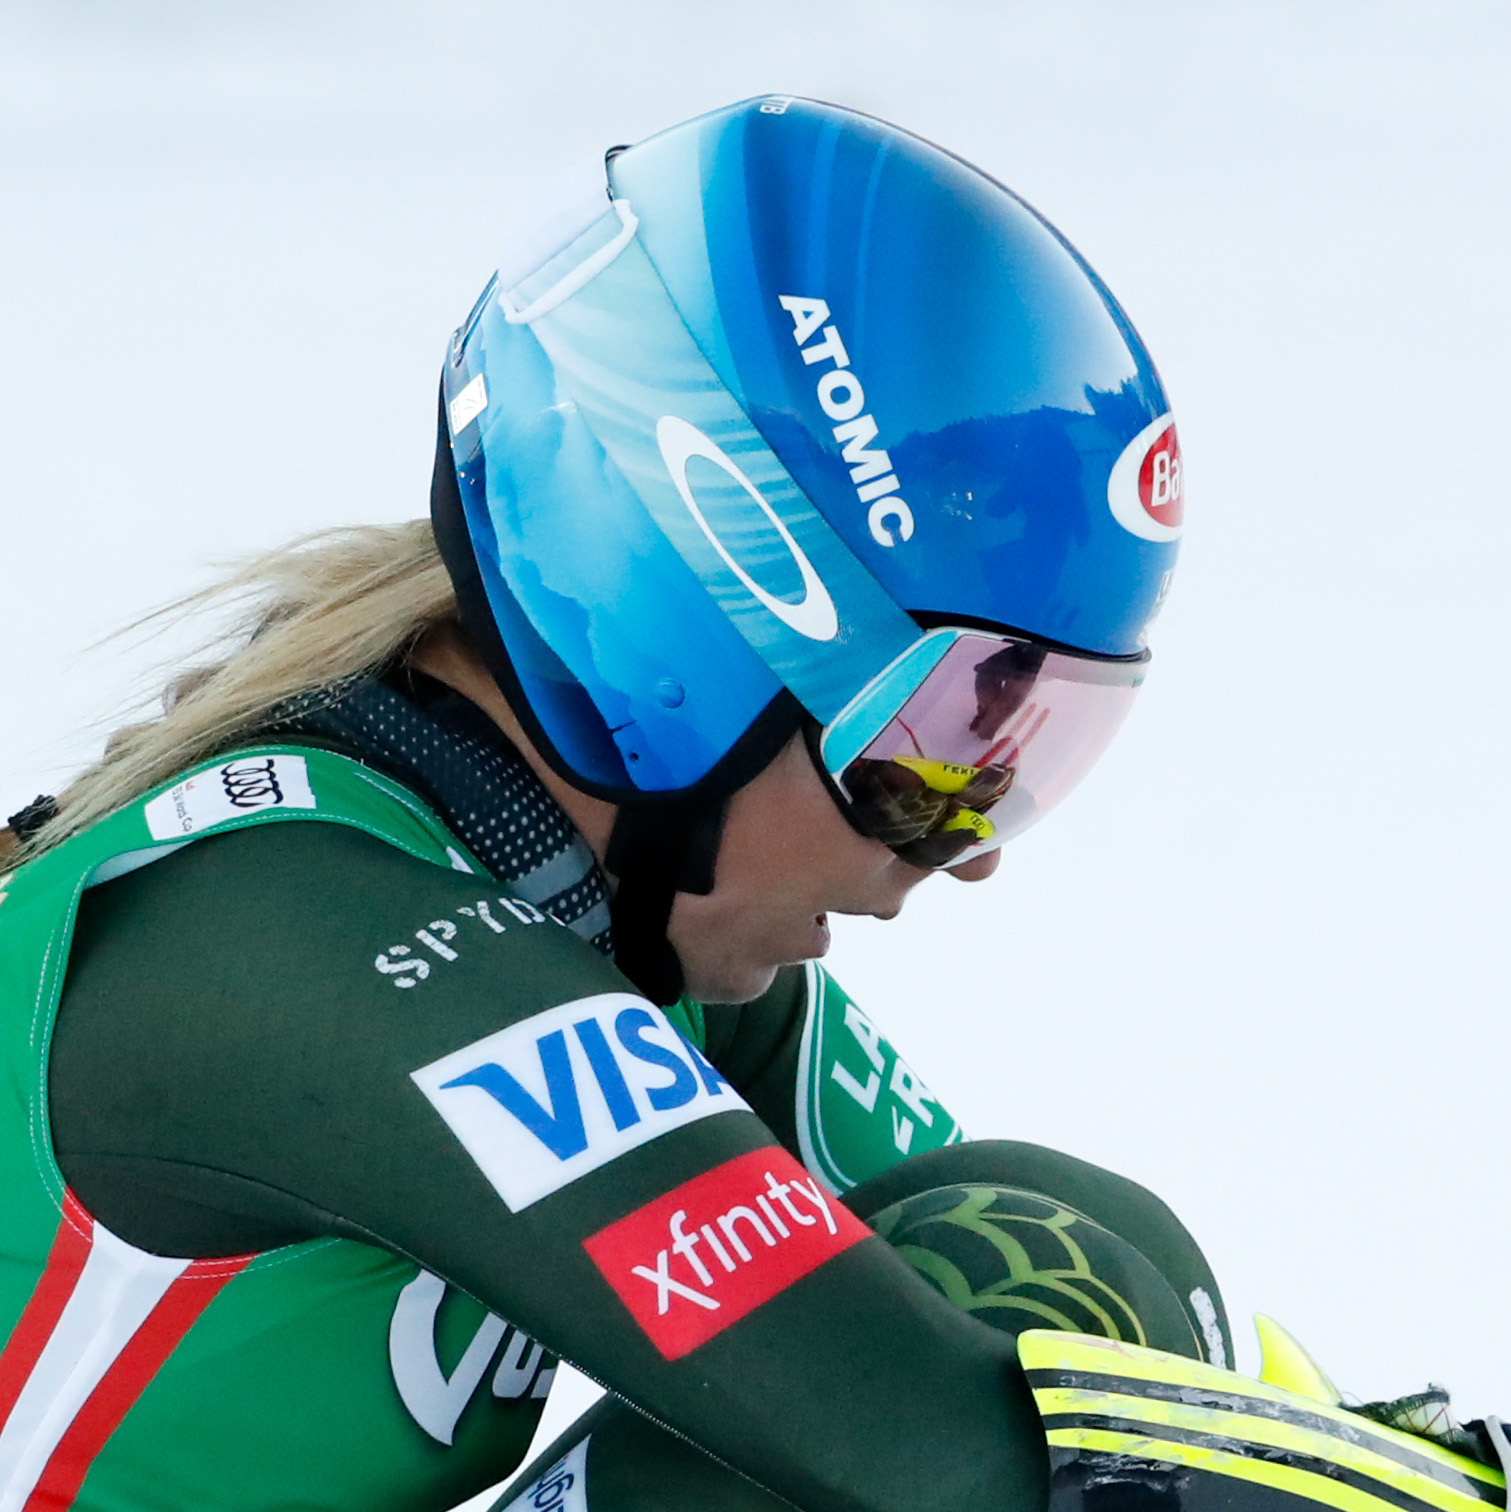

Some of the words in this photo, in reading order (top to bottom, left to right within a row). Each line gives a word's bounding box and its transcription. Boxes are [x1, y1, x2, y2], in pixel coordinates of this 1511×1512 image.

[778, 294, 916, 548] ATOMIC
[375, 897, 567, 989] SPYD
[439, 1007, 730, 1162] VISA
[631, 1171, 839, 1316] xfinity
